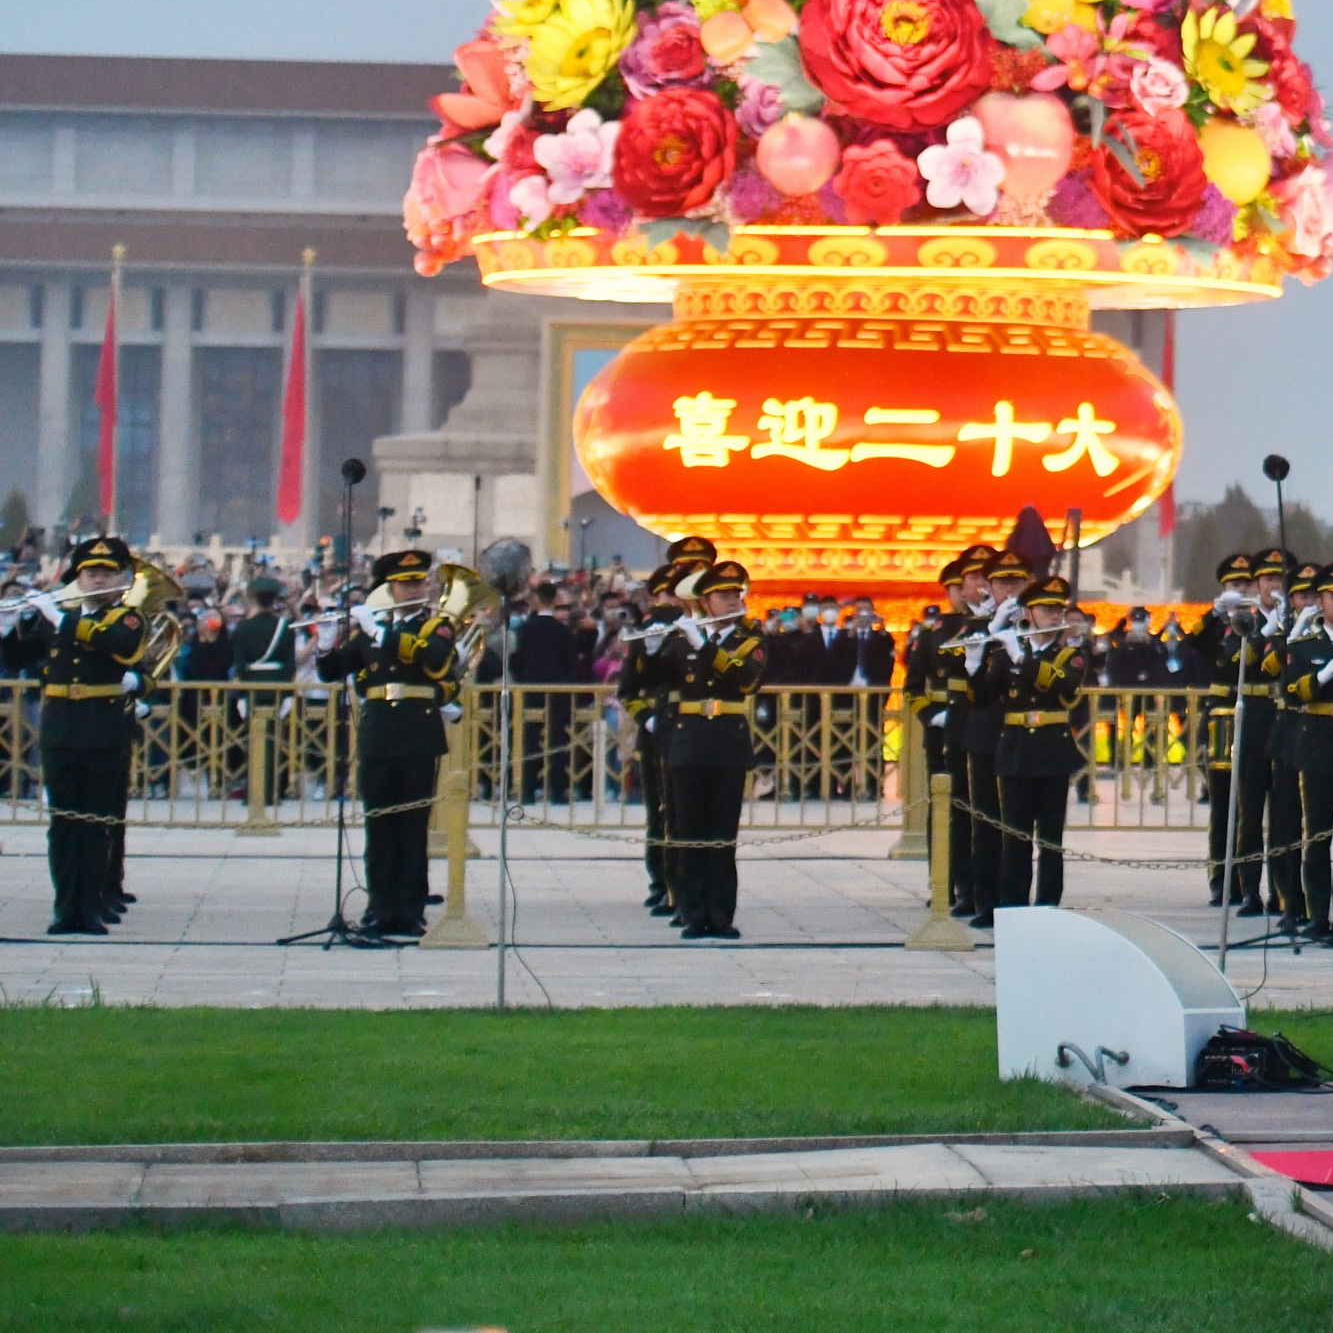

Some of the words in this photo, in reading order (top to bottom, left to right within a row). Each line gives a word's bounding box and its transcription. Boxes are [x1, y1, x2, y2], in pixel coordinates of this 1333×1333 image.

[662, 390, 1121, 478] 喜迎二十大
